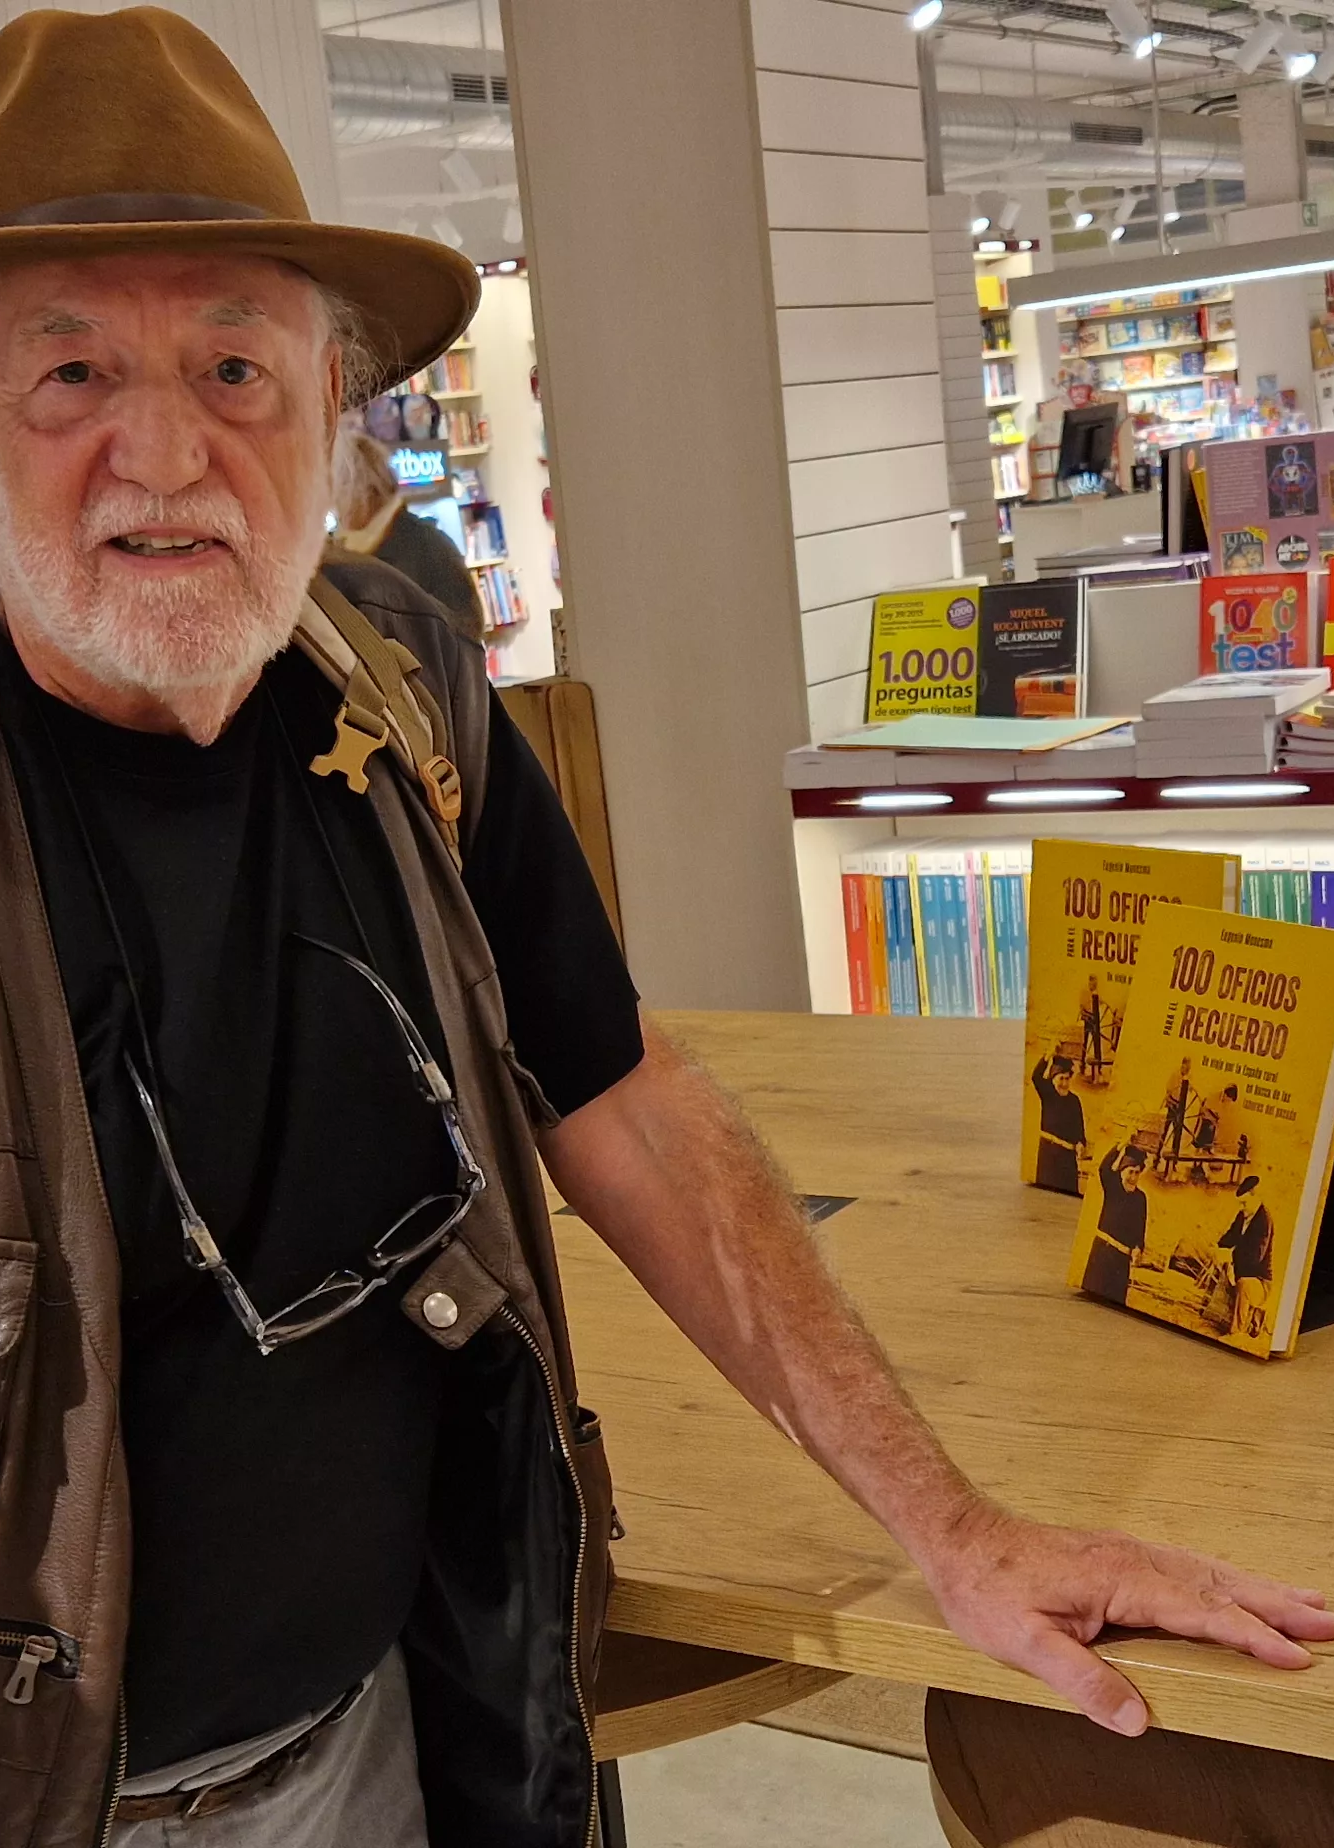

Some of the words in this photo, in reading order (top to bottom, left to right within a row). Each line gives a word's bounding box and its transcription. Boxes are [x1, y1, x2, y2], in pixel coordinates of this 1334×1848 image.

[949, 605, 973, 618] 1.000
[1010, 607, 1048, 619] MIQUEL
[993, 620, 1019, 633] ROCA
[1020, 618, 1065, 632] JUNYENT
[1212, 632, 1295, 673] test
[878, 646, 975, 684] 1.000
[875, 684, 973, 705] preguntas
[875, 705, 887, 717] de
[888, 707, 930, 717] examen
[931, 705, 951, 715] tipo
[952, 704, 972, 714] test
[1062, 876, 1101, 920] 100
[1109, 890, 1183, 925] OFIC
[1066, 938, 1075, 958] PARA
[1220, 928, 1244, 945] Eugenio
[1244, 934, 1274, 949] Monesma
[1169, 944, 1215, 996] 100
[1217, 963, 1301, 1013] OFICIOS
[1163, 1012, 1176, 1037] PARA
[1170, 1001, 1179, 1012] EL
[1178, 1003, 1289, 1060] RECUERDO
[1225, 1062, 1234, 1074] por
[1242, 1065, 1263, 1081] España
